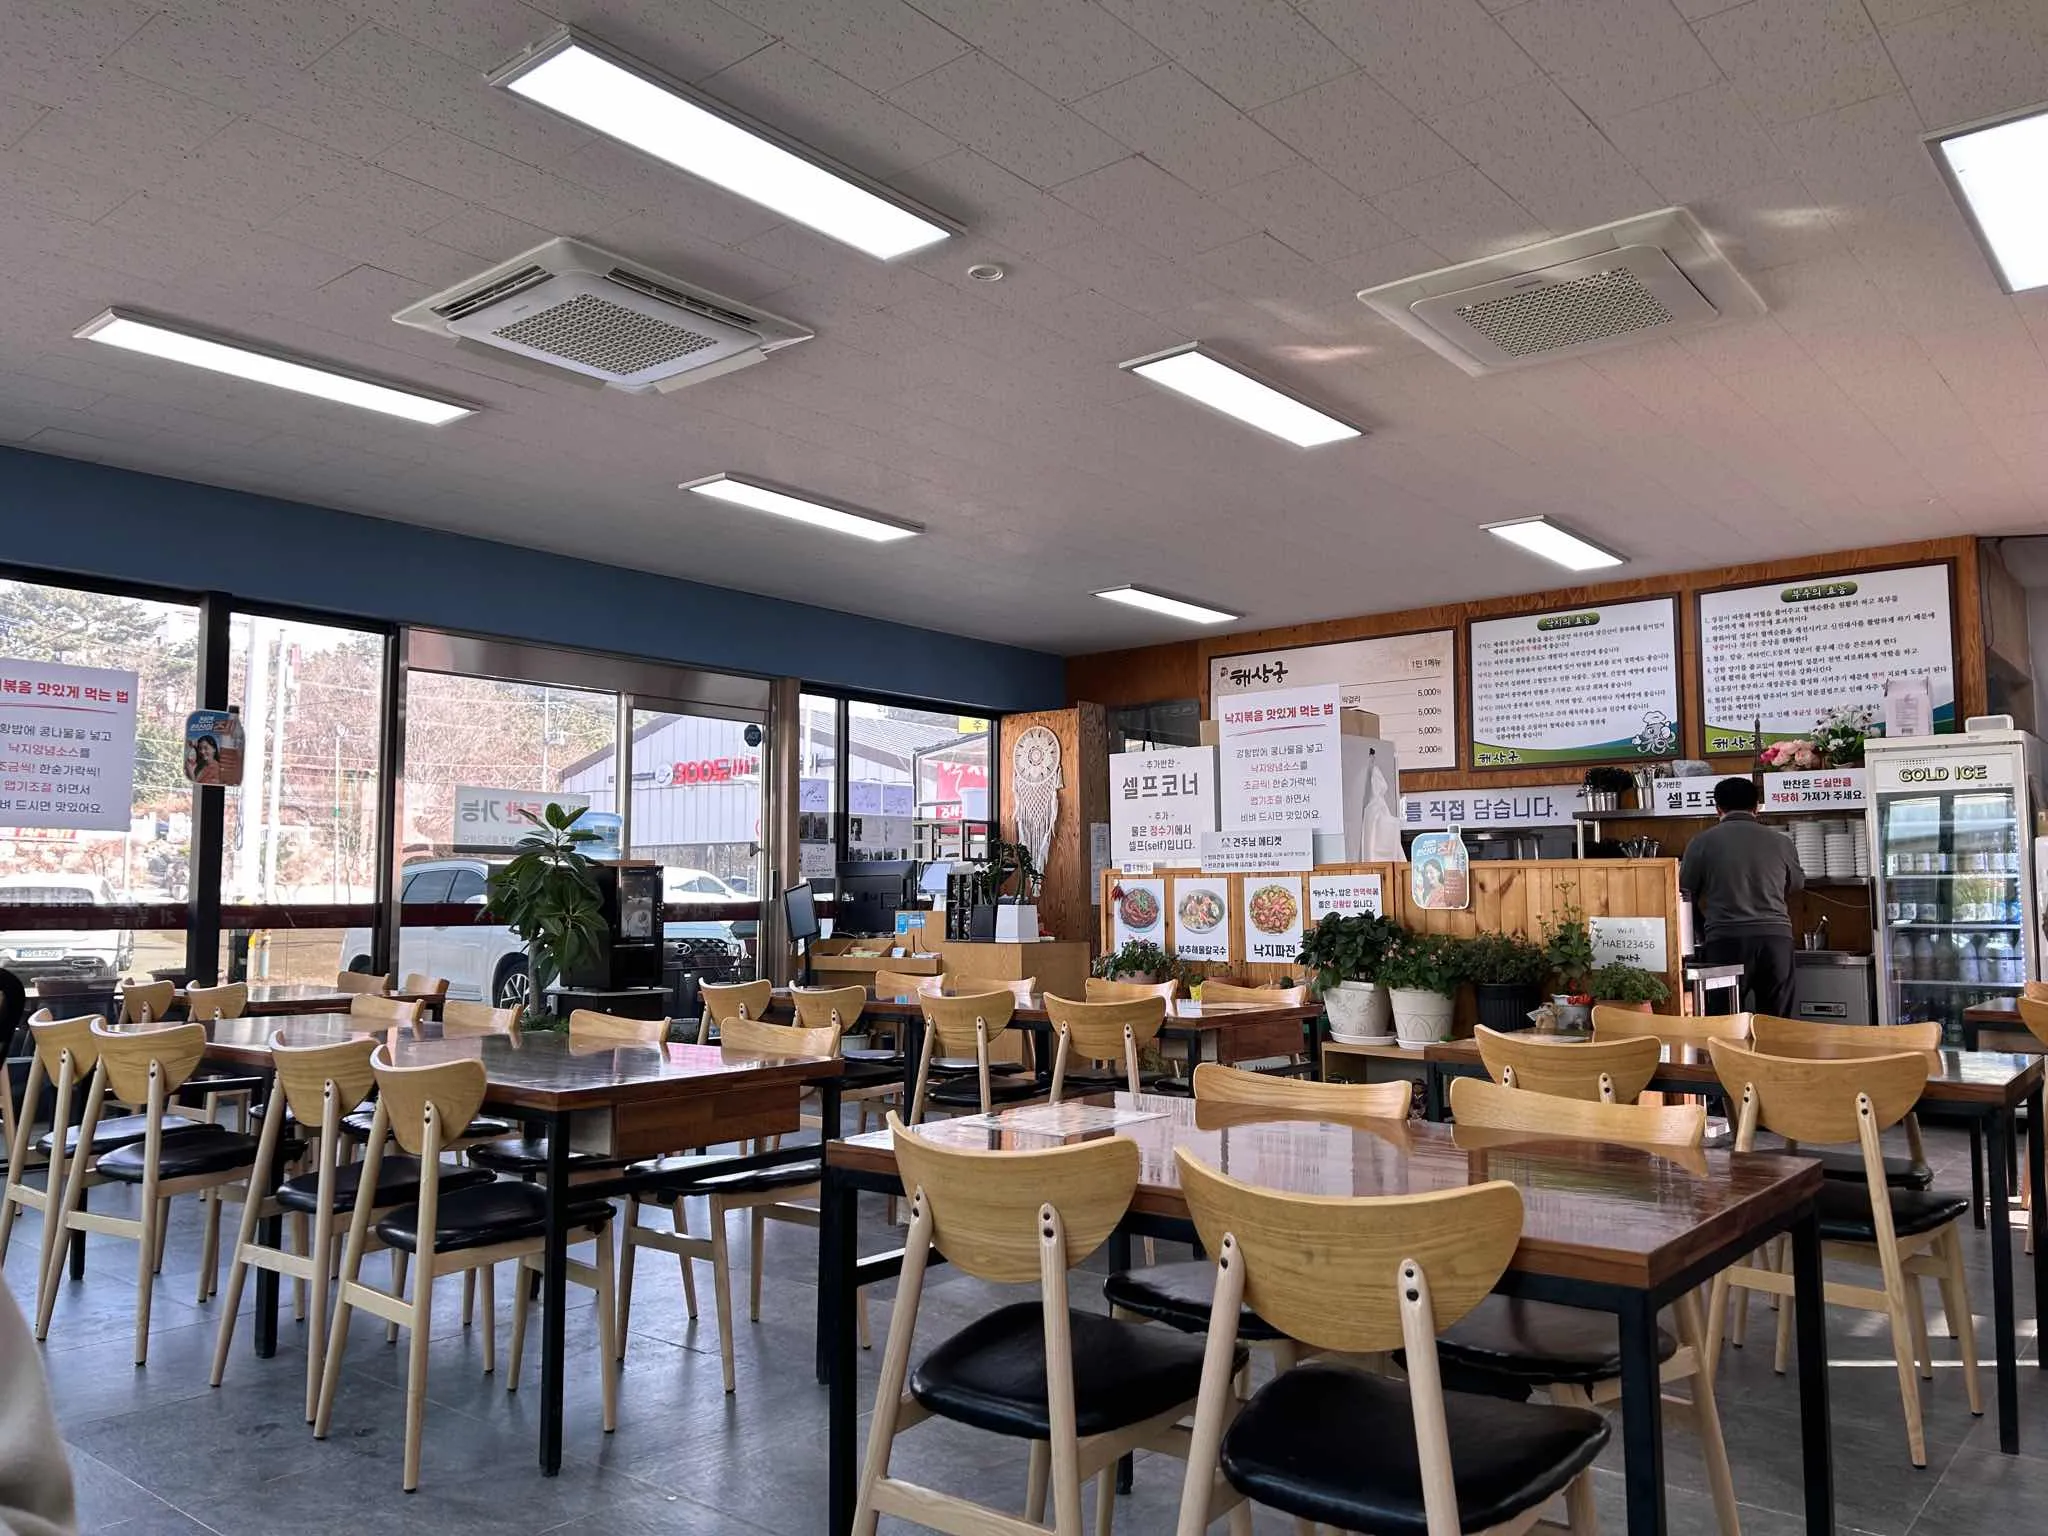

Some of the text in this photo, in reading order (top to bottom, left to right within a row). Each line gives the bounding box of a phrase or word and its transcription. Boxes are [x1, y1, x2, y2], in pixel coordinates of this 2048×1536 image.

[1826, 582, 1847, 595] 효능
[1230, 661, 1288, 687] 해상궁
[0, 679, 129, 704] 볶음 맛있게 먹는 법
[1224, 702, 1334, 725] 낙지볶음 맛있게 먹는 법
[39, 726, 87, 742] 콩나물을
[90, 730, 113, 743] 넣고
[8, 743, 91, 759] 낙지양념소스를
[1899, 765, 1989, 783] GOLD ICE
[4, 780, 91, 796] 맵기조절 하면서
[1122, 771, 1199, 800] 셀프코너
[1782, 776, 1852, 790] 반찬은 드실만큼
[1285, 793, 1311, 805] 하면서
[1771, 789, 1867, 804] 적당히 가져가 주세요.
[15, 801, 51, 813] 드시면
[55, 803, 105, 815] 맛있어요.
[1405, 796, 1559, 823] 를 직접 담습니다.
[1258, 810, 1284, 822] 드시면
[1150, 824, 1192, 837] 정수기에서
[1128, 838, 1196, 852] 셀프(self)입니다.
[1233, 836, 1256, 848] 견주님
[1178, 944, 1227, 957] 부추해물칼국수
[1253, 944, 1296, 958] 낙지파전
[1602, 939, 1656, 950] HAE123456
